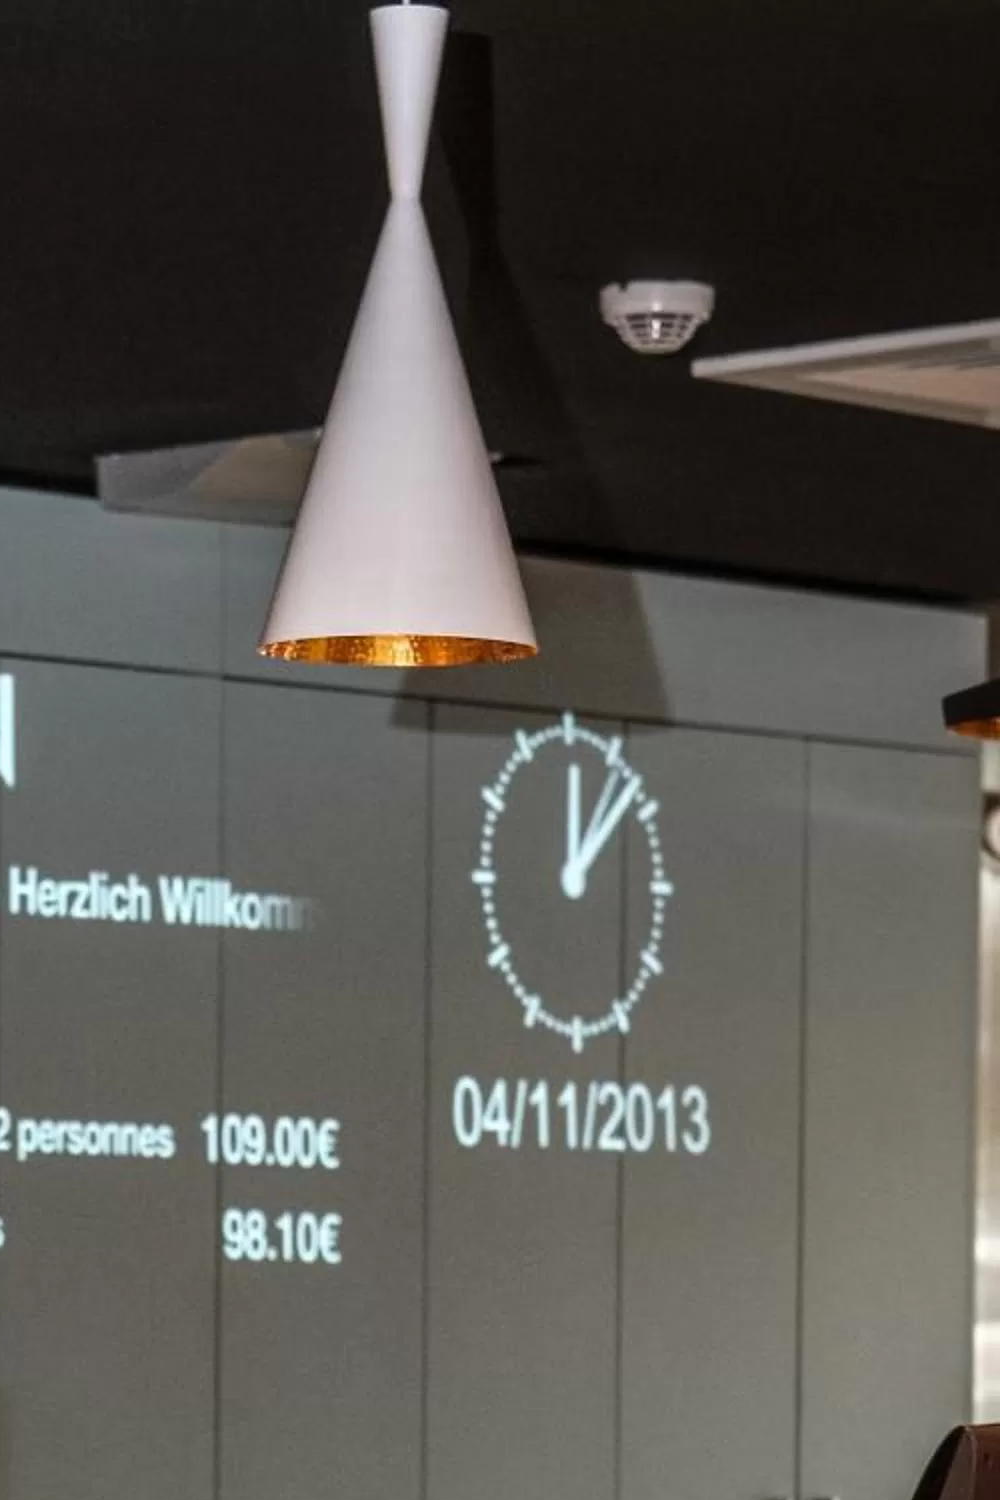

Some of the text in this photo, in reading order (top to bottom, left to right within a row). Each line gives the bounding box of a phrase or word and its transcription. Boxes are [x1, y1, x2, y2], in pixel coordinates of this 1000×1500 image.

[8, 864, 152, 923] Herzlich
[16, 1114, 176, 1161] personnes
[201, 1112, 340, 1169] 109.00€
[453, 1075, 711, 1154] 04/11/2013
[222, 1207, 342, 1264] 98.10€
